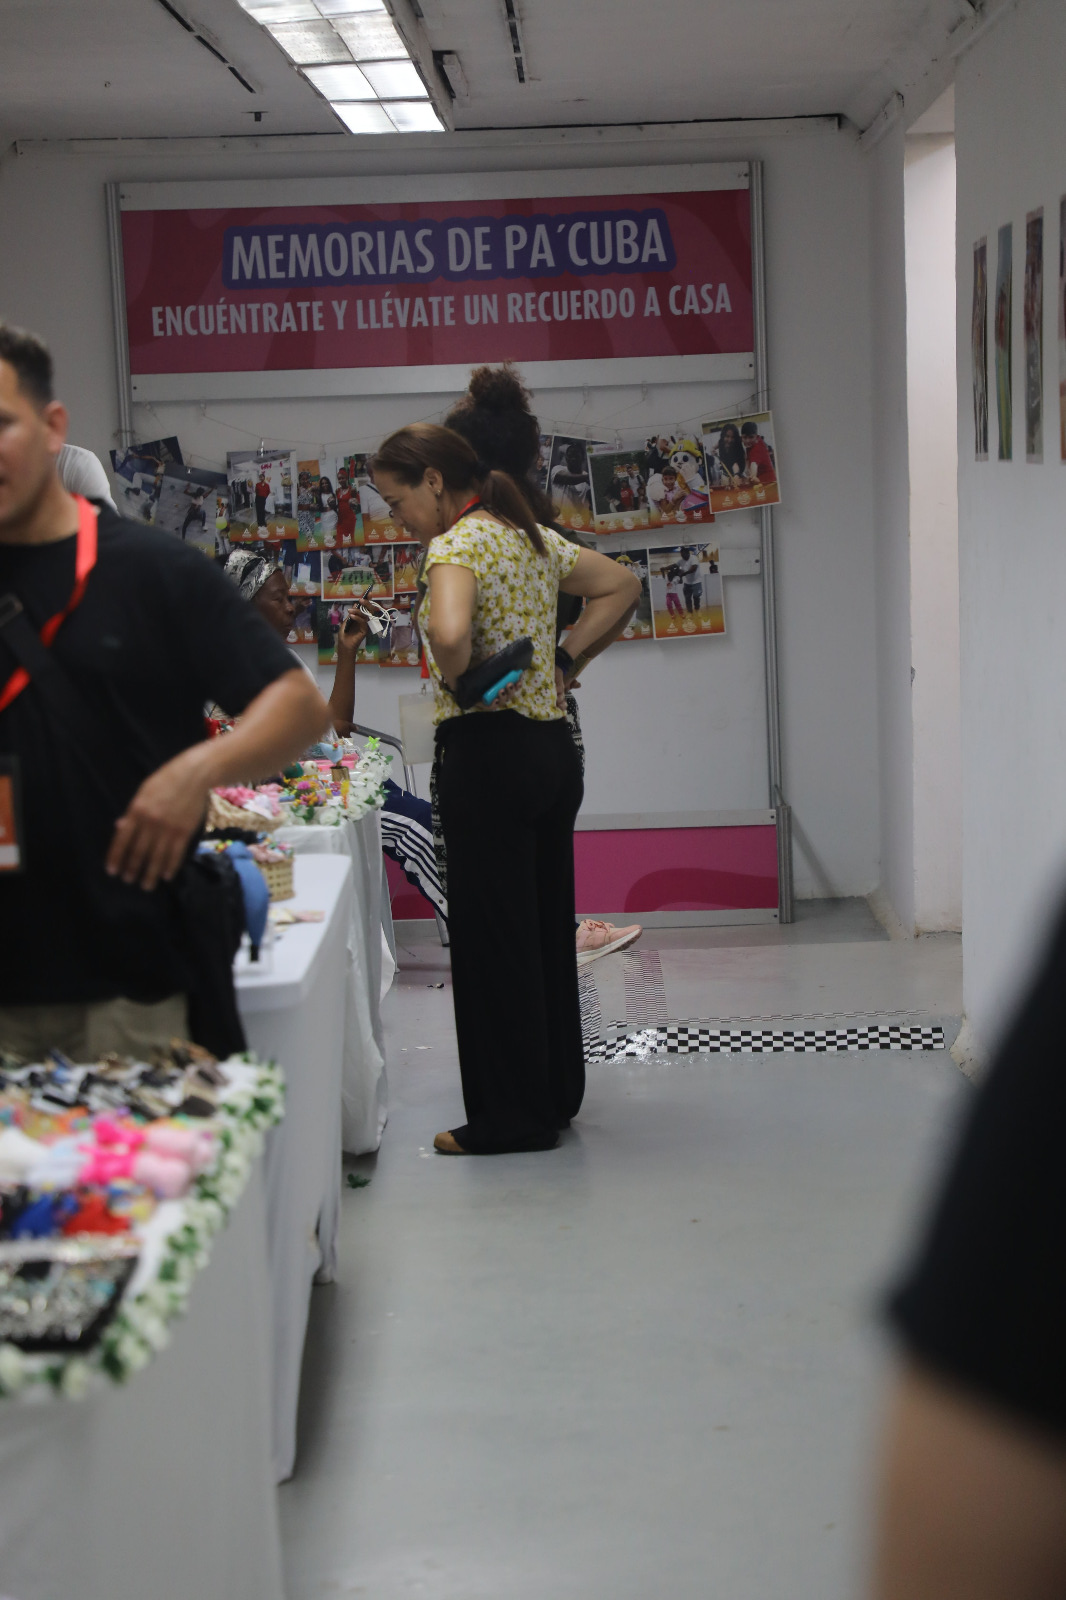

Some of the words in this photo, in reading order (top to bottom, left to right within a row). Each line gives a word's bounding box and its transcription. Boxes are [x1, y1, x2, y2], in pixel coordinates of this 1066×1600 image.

[231, 228, 435, 280] MEMORIAS
[447, 226, 493, 272] DE
[152, 298, 325, 337] ENCUÉNTRATE
[331, 299, 348, 330] Y
[356, 291, 456, 330] LLÉVATE
[463, 294, 499, 326] UN
[507, 287, 635, 324] RECUERDO
[644, 286, 661, 317] A
[669, 283, 732, 316] CASA
